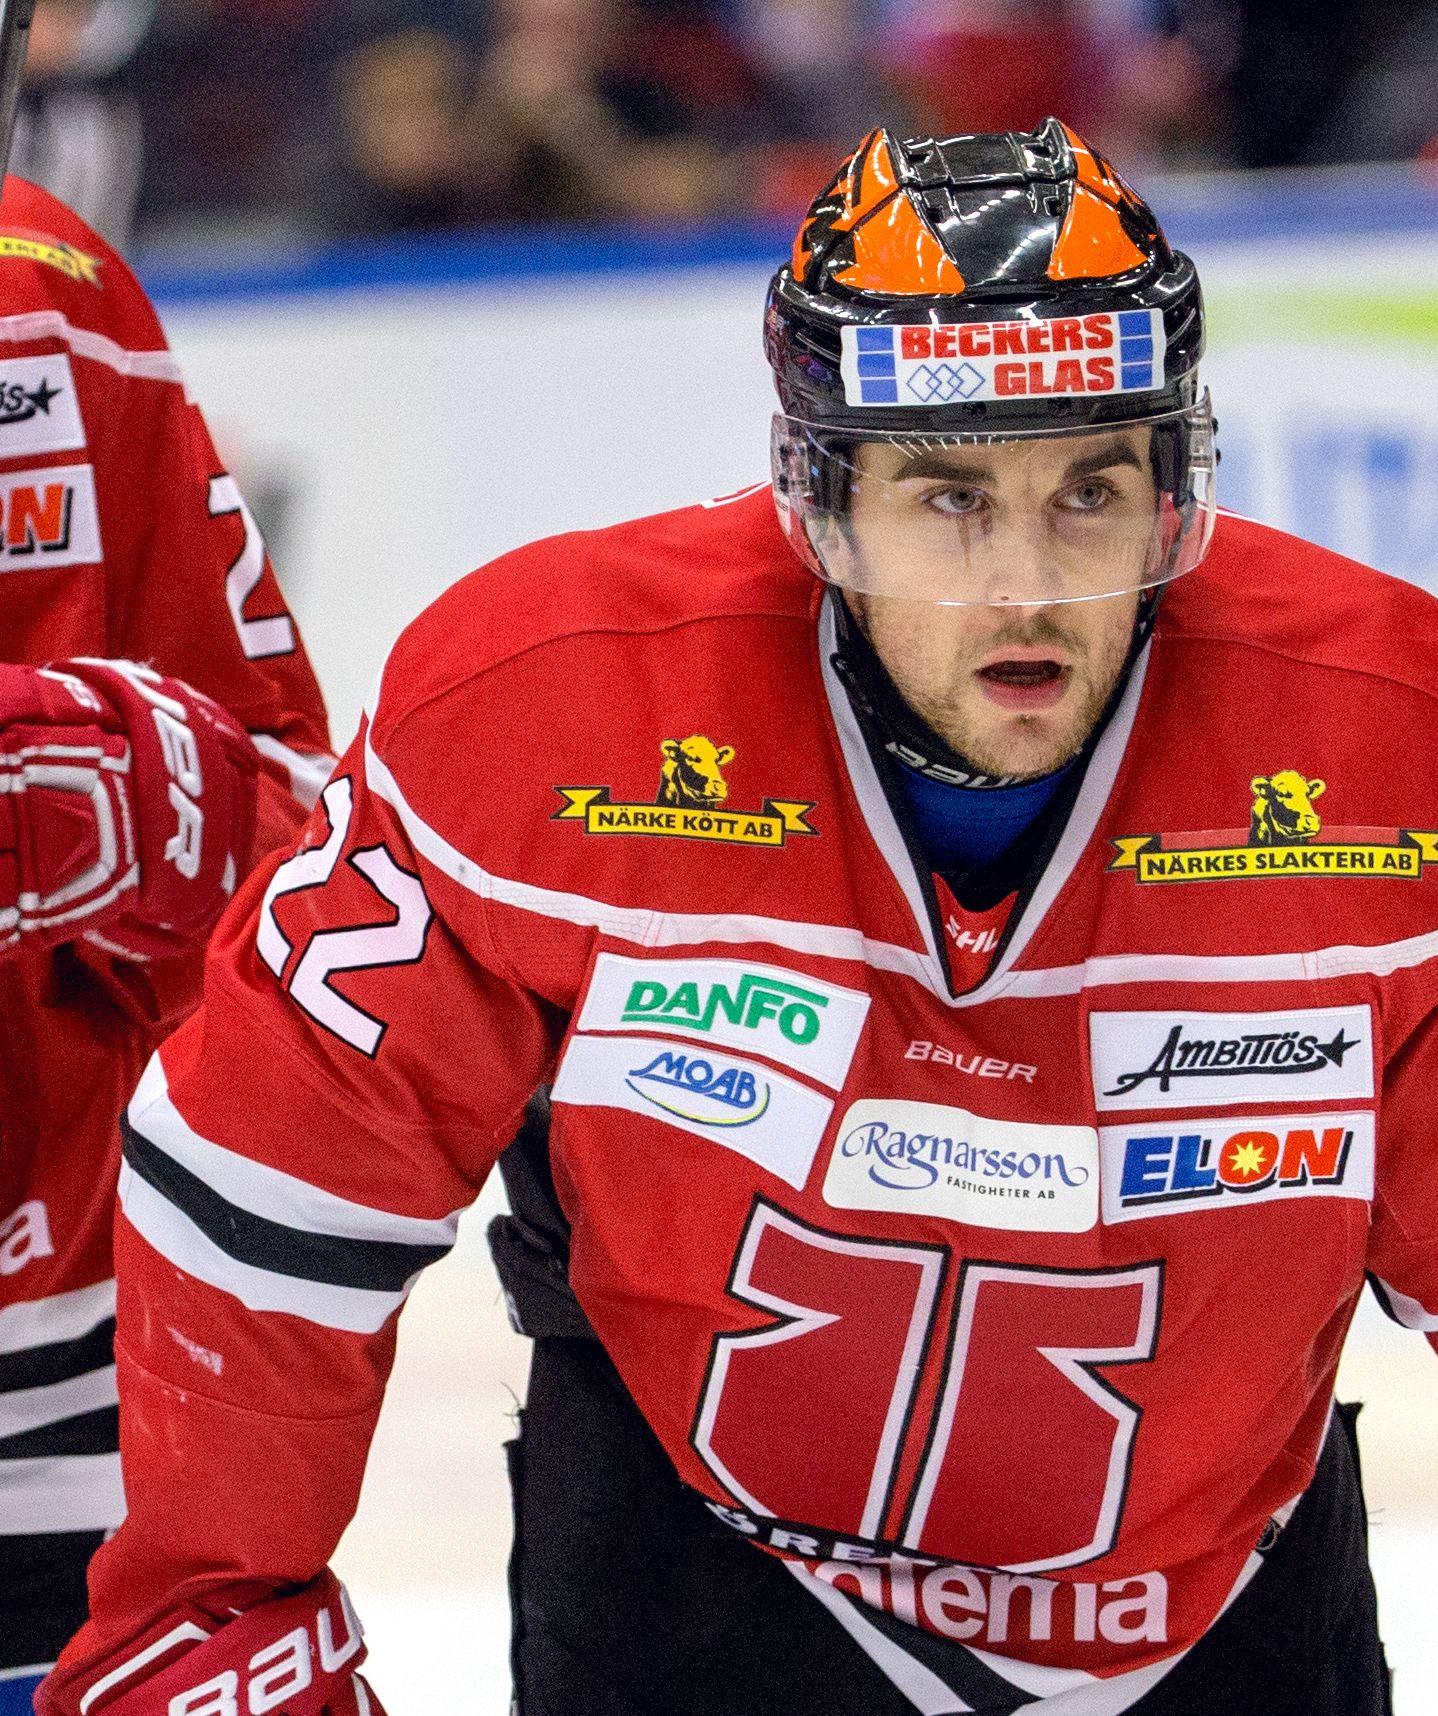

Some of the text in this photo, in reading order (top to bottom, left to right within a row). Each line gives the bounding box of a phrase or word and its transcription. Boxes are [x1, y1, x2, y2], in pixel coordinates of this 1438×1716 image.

[901, 314, 1115, 360] BECKERS
[993, 356, 1116, 396] GLAS
[597, 807, 774, 838] NÄRKE KÖTT AB
[1146, 851, 1413, 876] NÄRKES SLAKTERI AB
[256, 775, 435, 1059] 22
[520, 842, 652, 1123] 2
[620, 973, 830, 1046] DANFO
[628, 1052, 756, 1109] MOAB
[904, 1040, 1038, 1083] BAUER
[841, 1121, 1090, 1190] Ragnarsson
[1119, 1127, 1354, 1208] ELON
[947, 1176, 1056, 1199] FASTIGHETER AB
